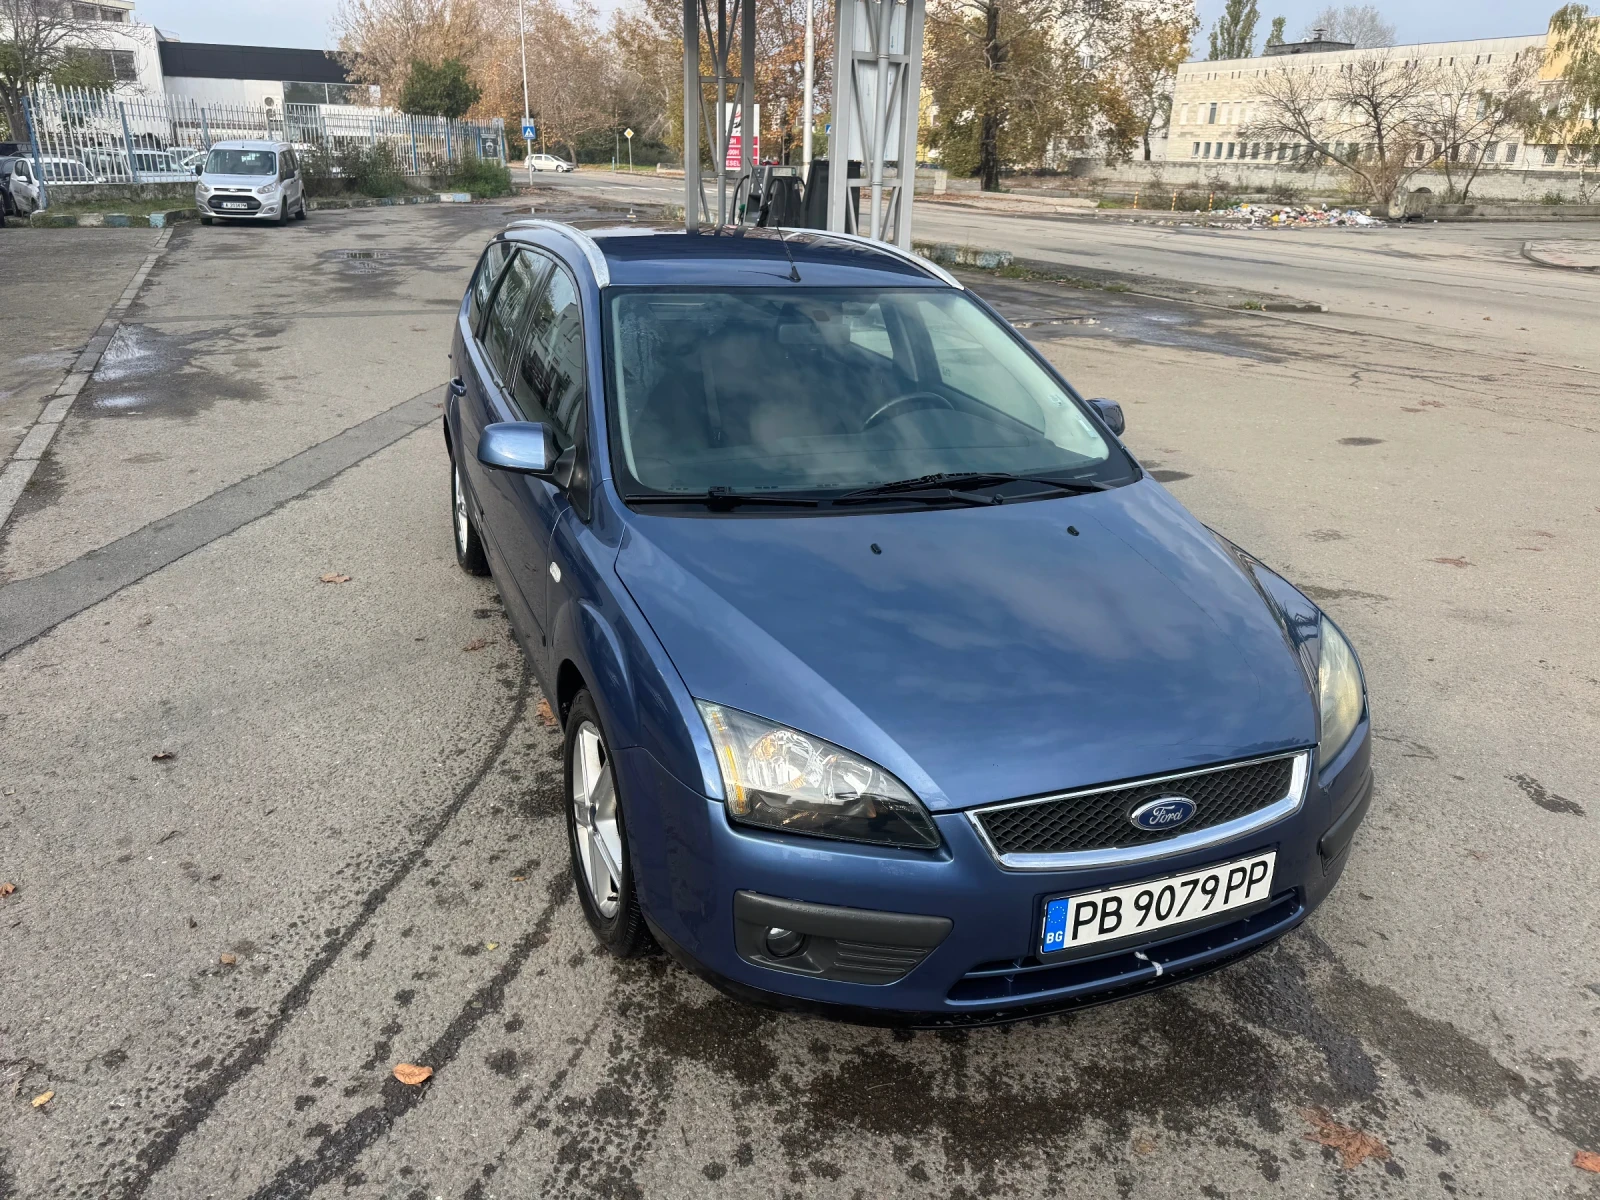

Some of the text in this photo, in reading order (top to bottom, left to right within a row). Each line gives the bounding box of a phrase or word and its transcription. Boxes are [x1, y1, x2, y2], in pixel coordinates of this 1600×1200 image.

[1149, 805, 1183, 824] Ford
[1046, 860, 1269, 944] BG PB 9079 PP
